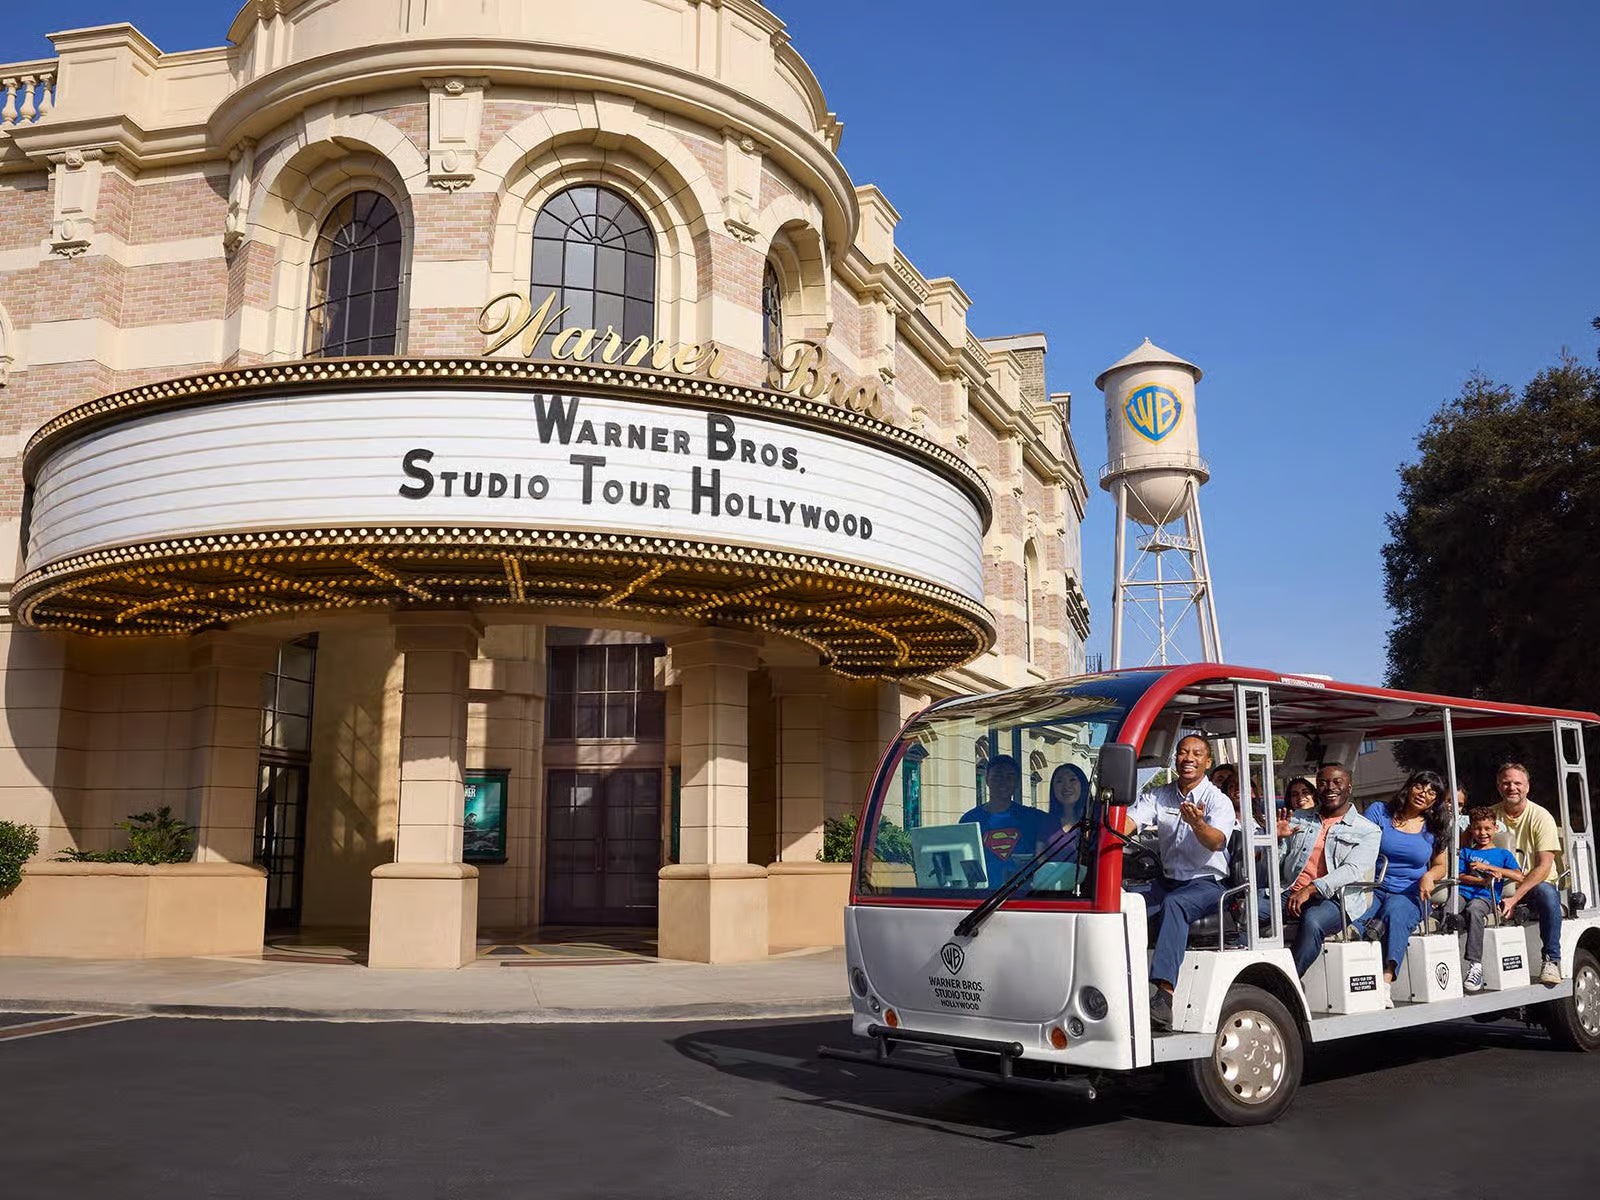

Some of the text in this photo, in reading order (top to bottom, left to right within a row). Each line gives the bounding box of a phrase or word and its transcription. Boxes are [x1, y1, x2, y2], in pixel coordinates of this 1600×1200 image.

[478, 290, 729, 379] Warner
[533, 394, 806, 474] WARNER BROS.
[399, 448, 874, 540] STUDIO TOUR HOLLYWOOD
[928, 976, 985, 992] WARNER BROS.
[934, 988, 981, 1002] STUDIO TOUR
[940, 999, 979, 1010] HOLLYWOOD
